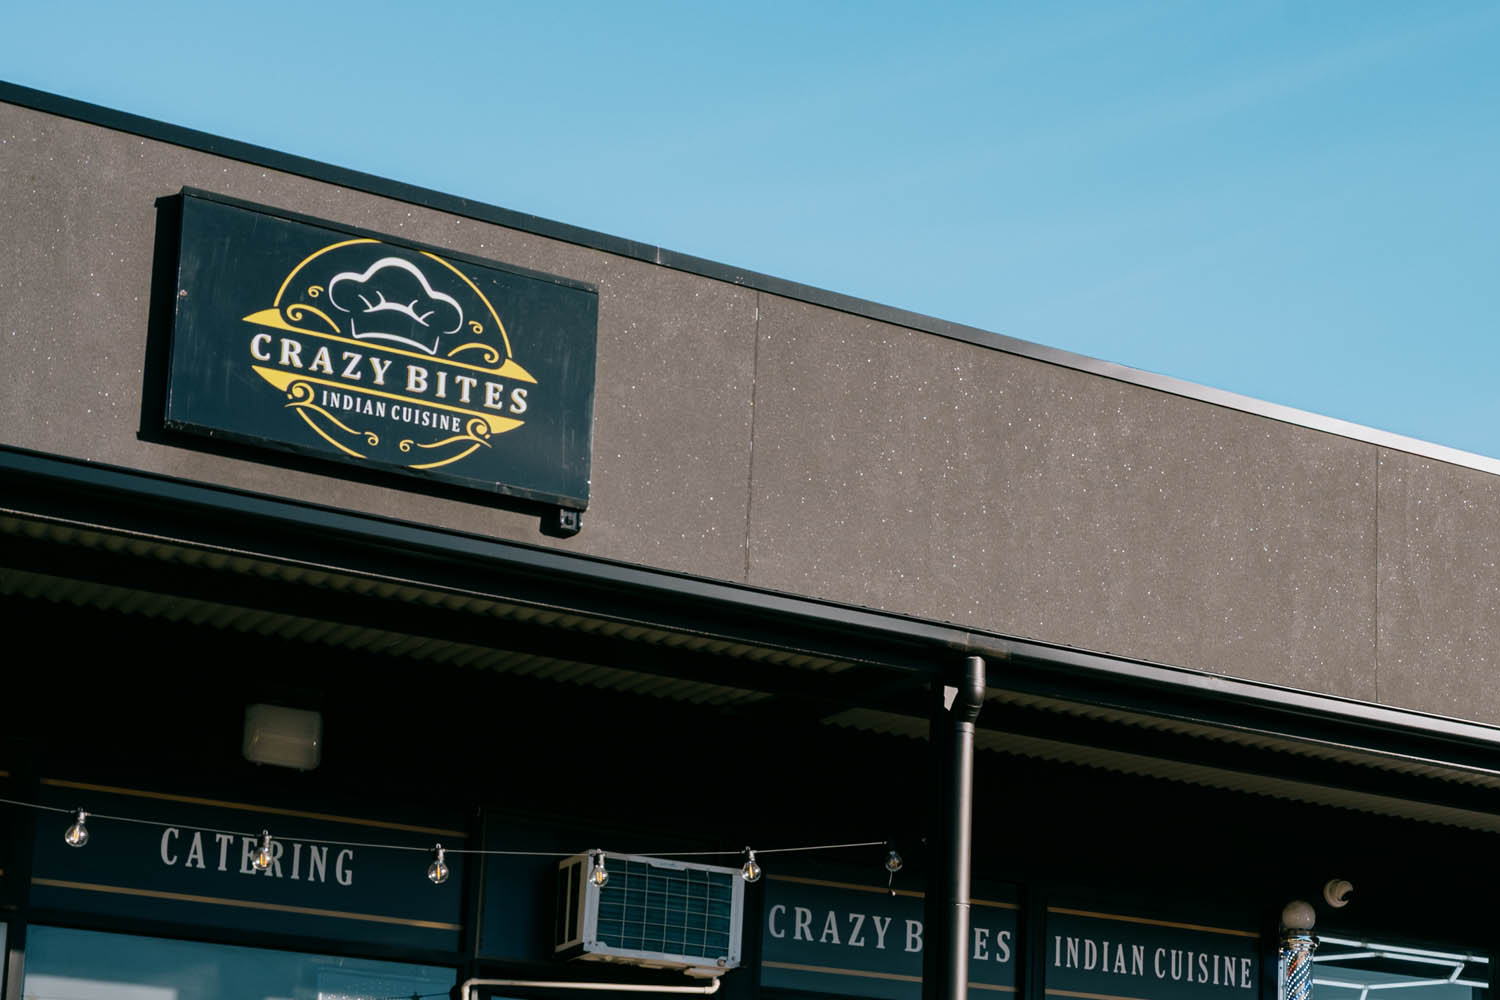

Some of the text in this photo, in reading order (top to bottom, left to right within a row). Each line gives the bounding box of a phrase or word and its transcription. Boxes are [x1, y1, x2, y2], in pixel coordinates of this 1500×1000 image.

[249, 332, 528, 415] CRAZY BITES
[321, 389, 462, 433] INDIAN CUISINE
[160, 827, 355, 887] CATERING
[767, 904, 1012, 964] CRAZY BES
[1053, 935, 1254, 990] INDIAN CUISINE
